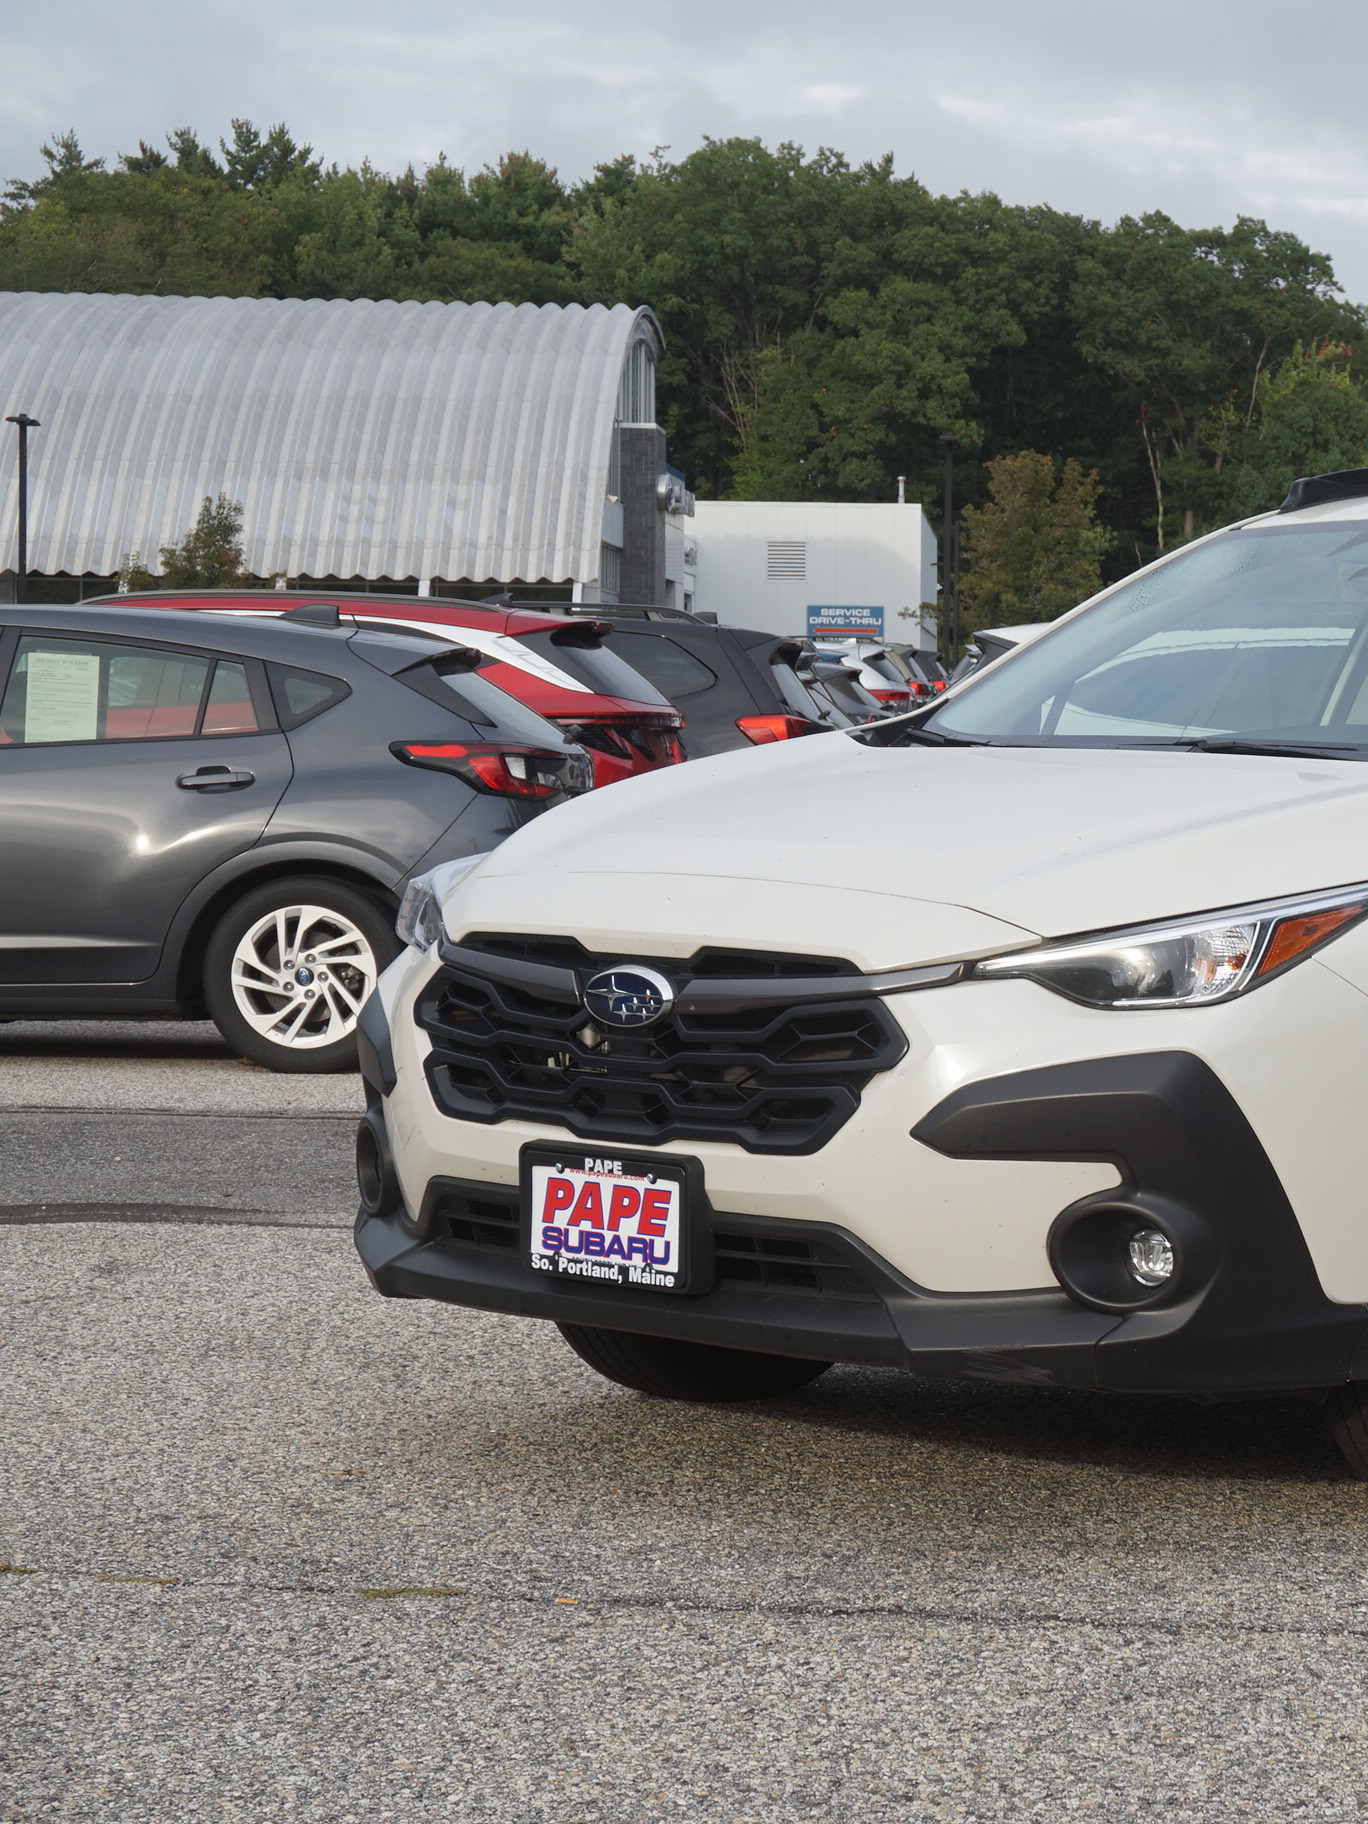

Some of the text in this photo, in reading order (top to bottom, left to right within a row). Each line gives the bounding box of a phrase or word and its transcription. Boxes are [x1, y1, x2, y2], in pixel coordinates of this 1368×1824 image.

[809, 616, 882, 625] DRIVE-THRU
[820, 607, 871, 617] SERVICE
[584, 1157, 623, 1175] PAPE
[541, 1176, 672, 1238] PAPE
[541, 1225, 671, 1266] SUBARU
[531, 1253, 553, 1270] So.
[558, 1257, 623, 1284] Portland,
[628, 1267, 675, 1288] Maine
